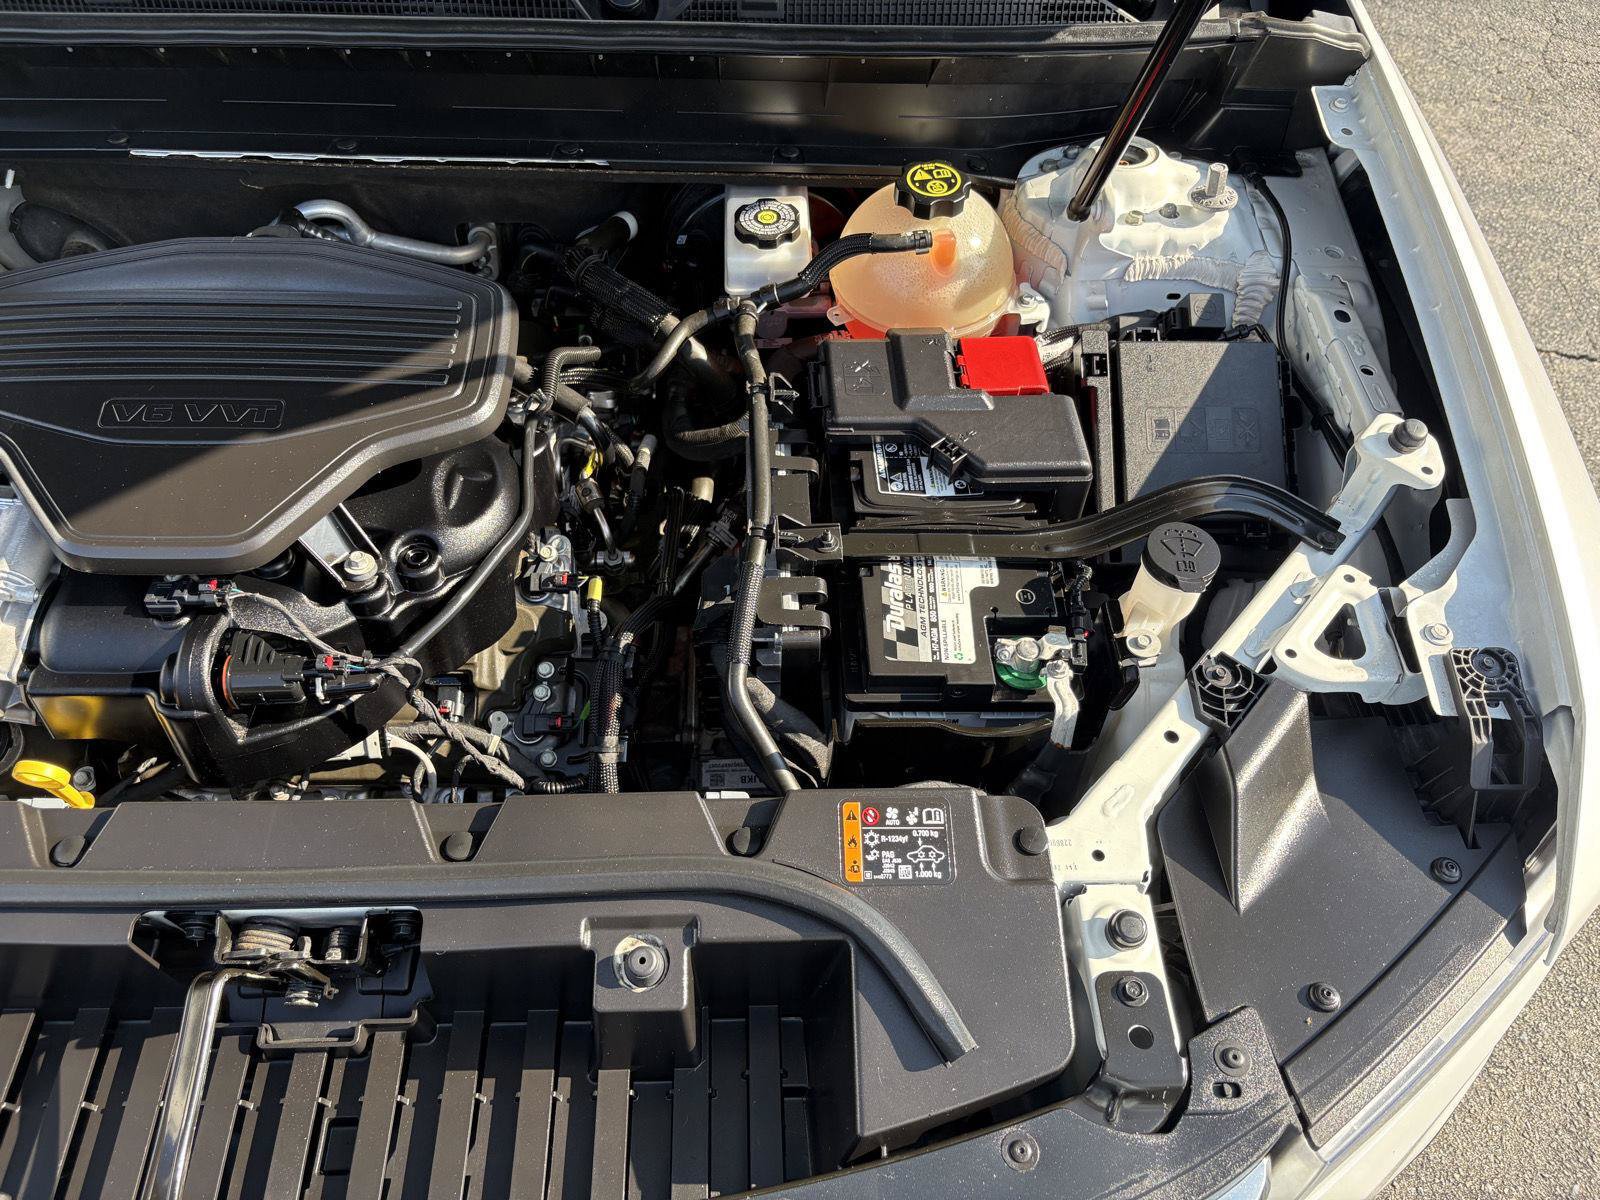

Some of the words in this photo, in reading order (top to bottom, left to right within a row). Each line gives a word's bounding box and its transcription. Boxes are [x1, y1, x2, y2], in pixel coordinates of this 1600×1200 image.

[111, 403, 174, 423] V6
[184, 403, 277, 423] VVT
[920, 616, 928, 638] AGM
[912, 829, 929, 837] 0.700
[929, 830, 939, 838] kg
[880, 835, 909, 843] R-1234yf
[881, 850, 895, 859] PAG
[914, 870, 933, 878] 1.000
[933, 871, 942, 879] kg
